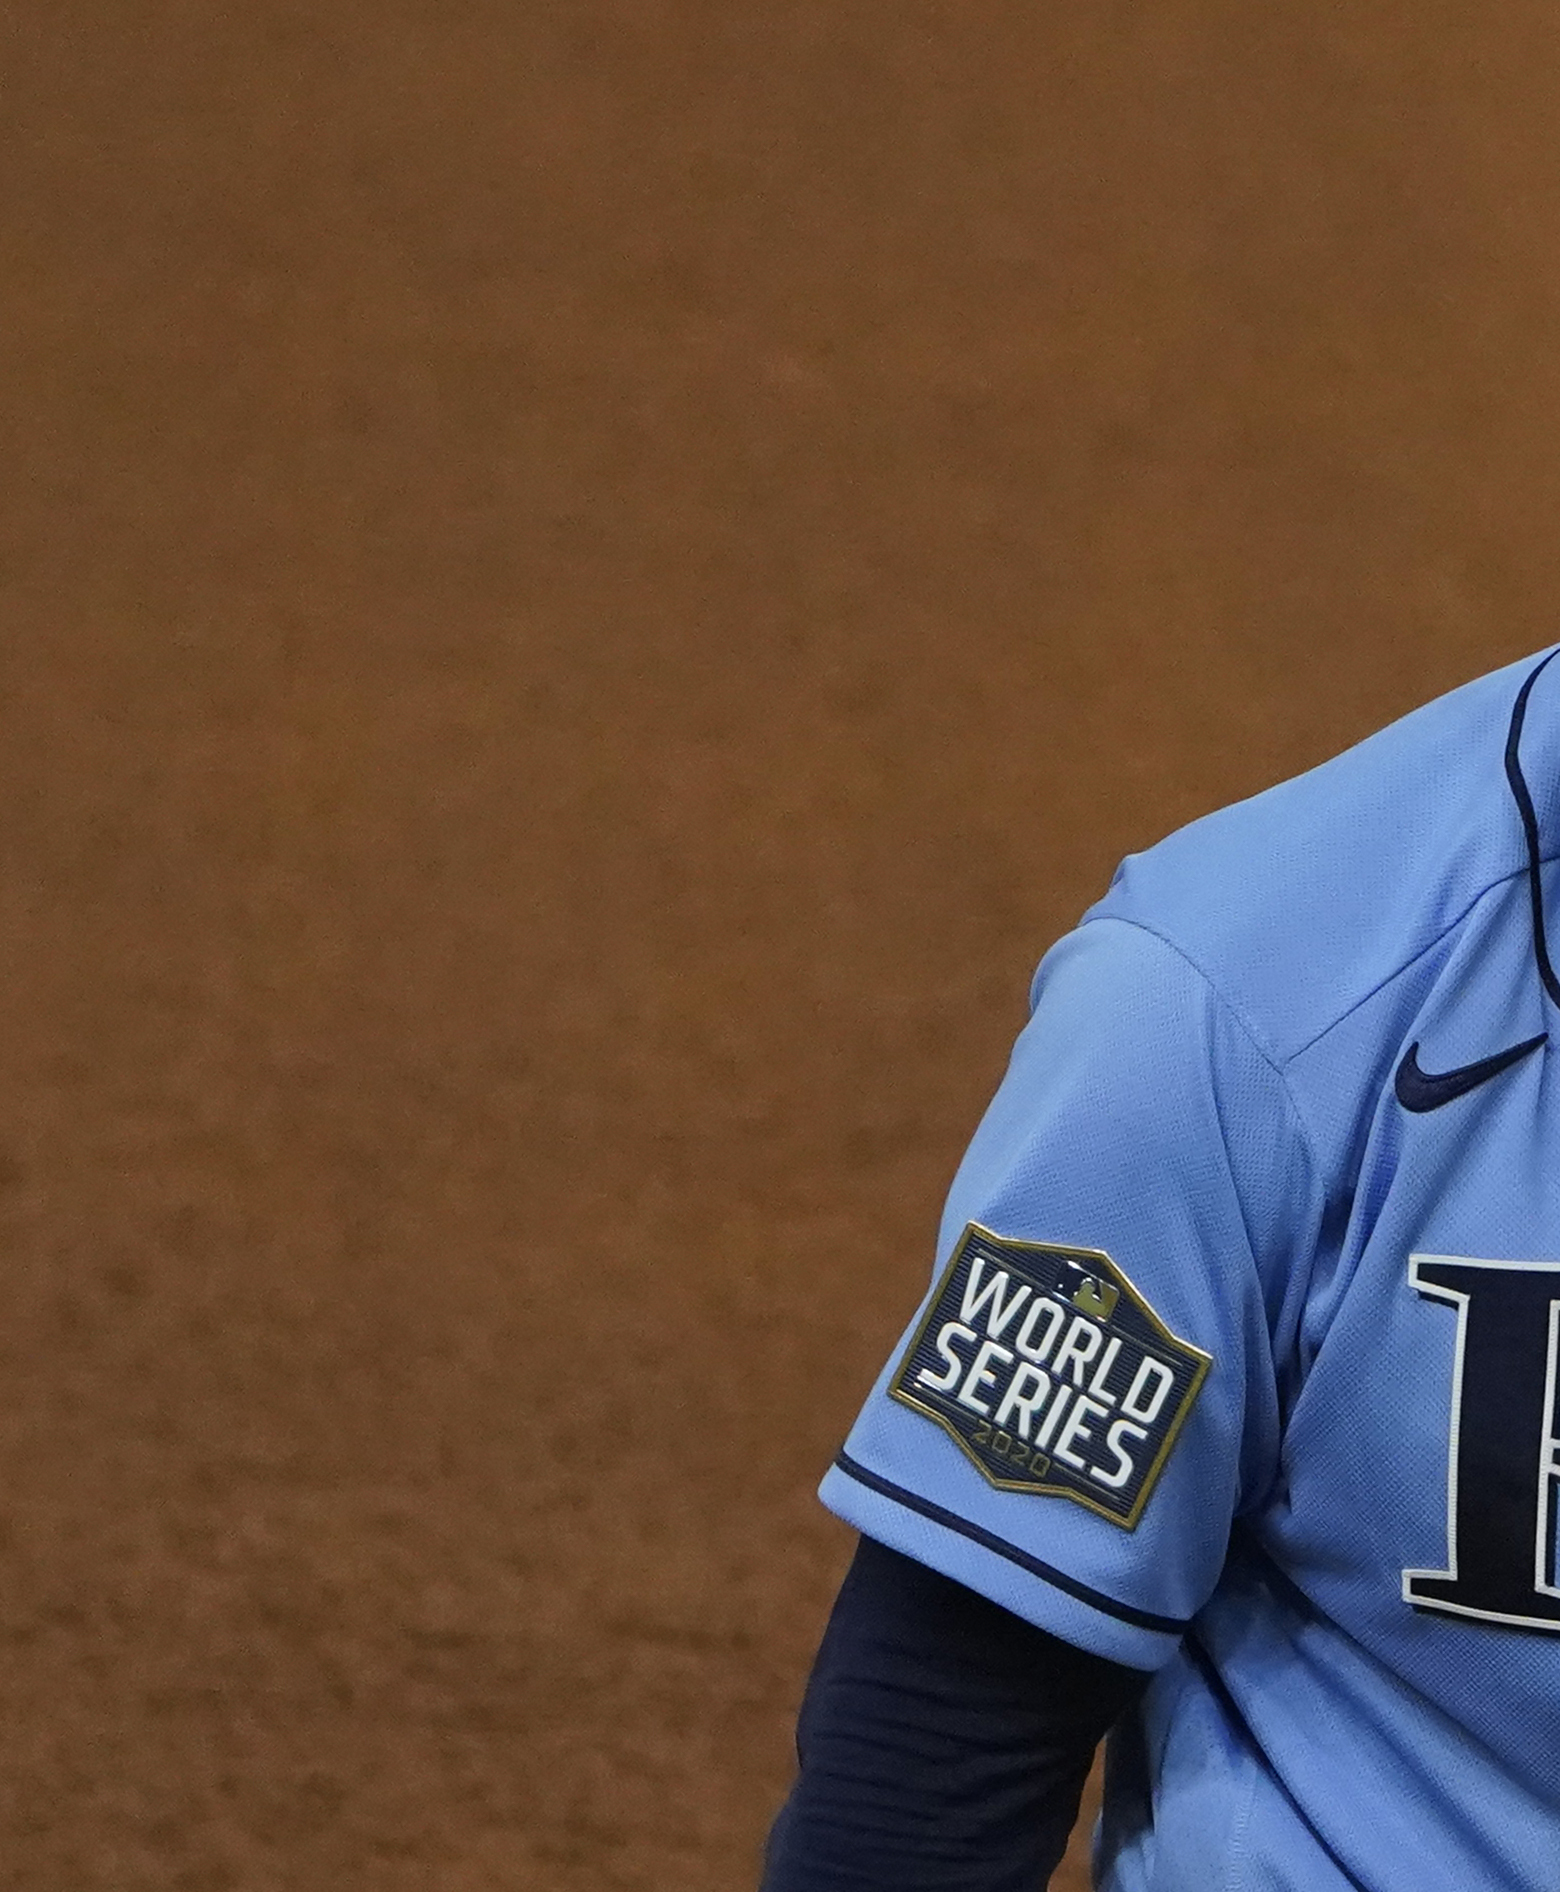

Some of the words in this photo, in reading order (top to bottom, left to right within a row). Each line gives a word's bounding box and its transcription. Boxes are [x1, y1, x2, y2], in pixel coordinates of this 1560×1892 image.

[916, 1321, 1149, 1488] SERIES
[959, 1256, 1174, 1424] WORLD
[972, 1421, 1051, 1477] 2020
